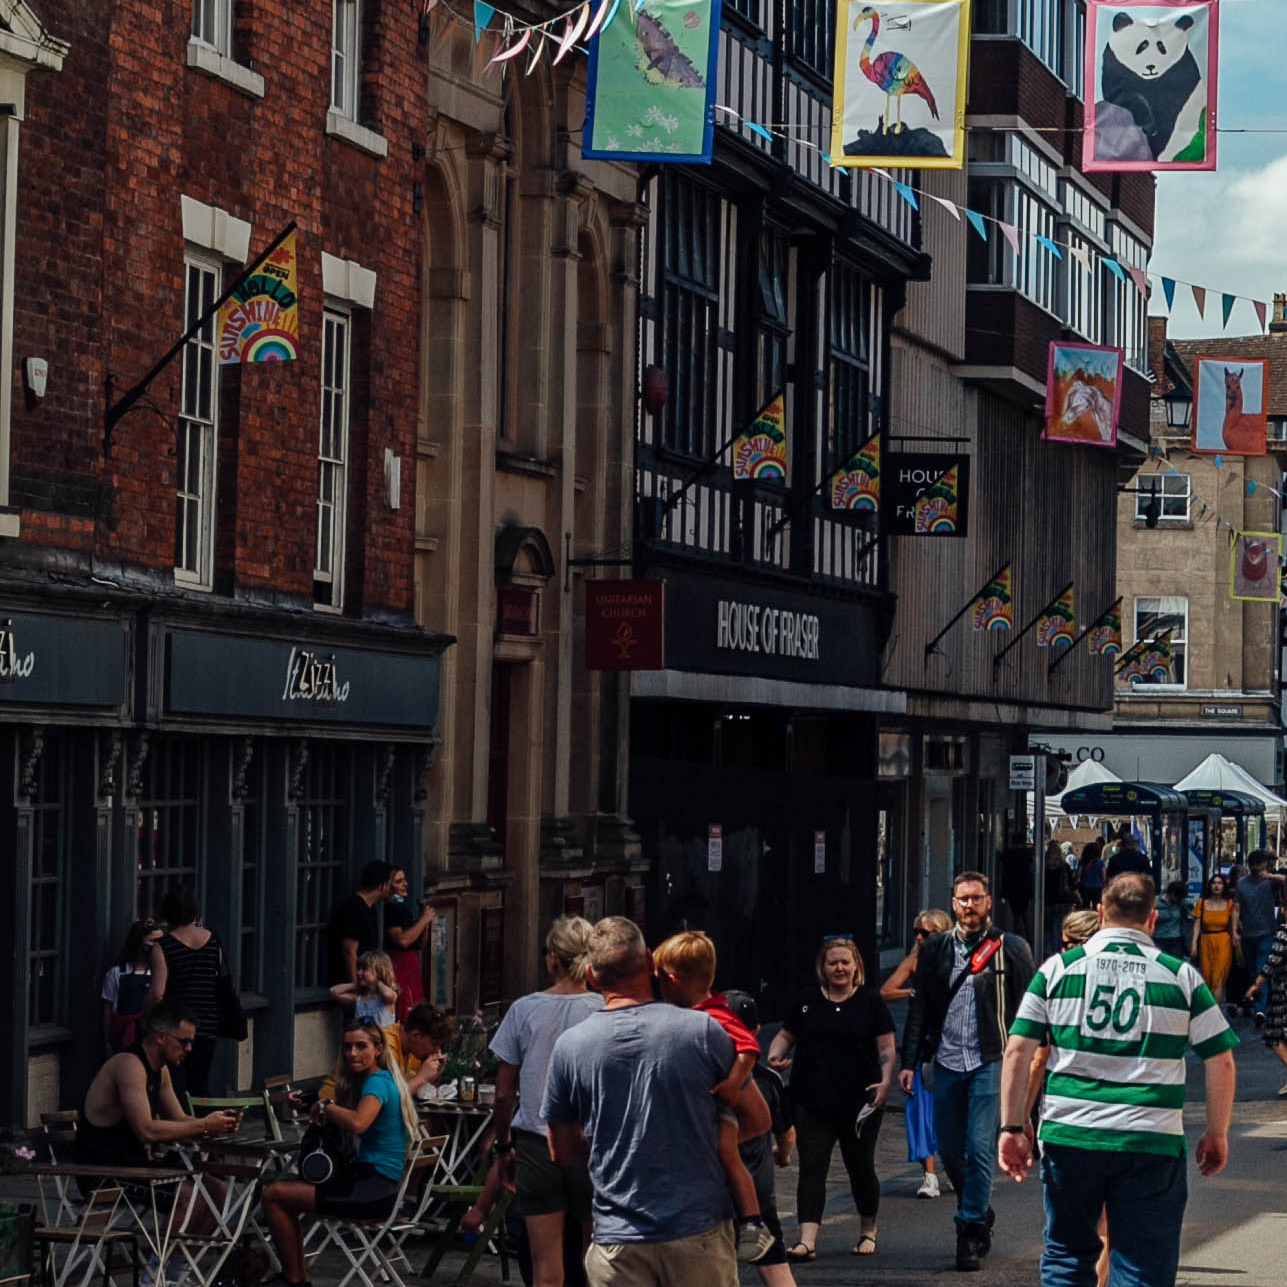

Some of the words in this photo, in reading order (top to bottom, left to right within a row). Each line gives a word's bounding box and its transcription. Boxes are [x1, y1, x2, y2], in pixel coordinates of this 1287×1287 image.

[600, 608, 647, 618] CHURCH
[717, 600, 760, 653] HOUSE
[761, 607, 779, 655] OF
[780, 611, 819, 660] FRASER
[299, 650, 337, 695] Zizzi
[1096, 958, 1147, 974] 1970-2019
[1086, 984, 1141, 1034] 50
